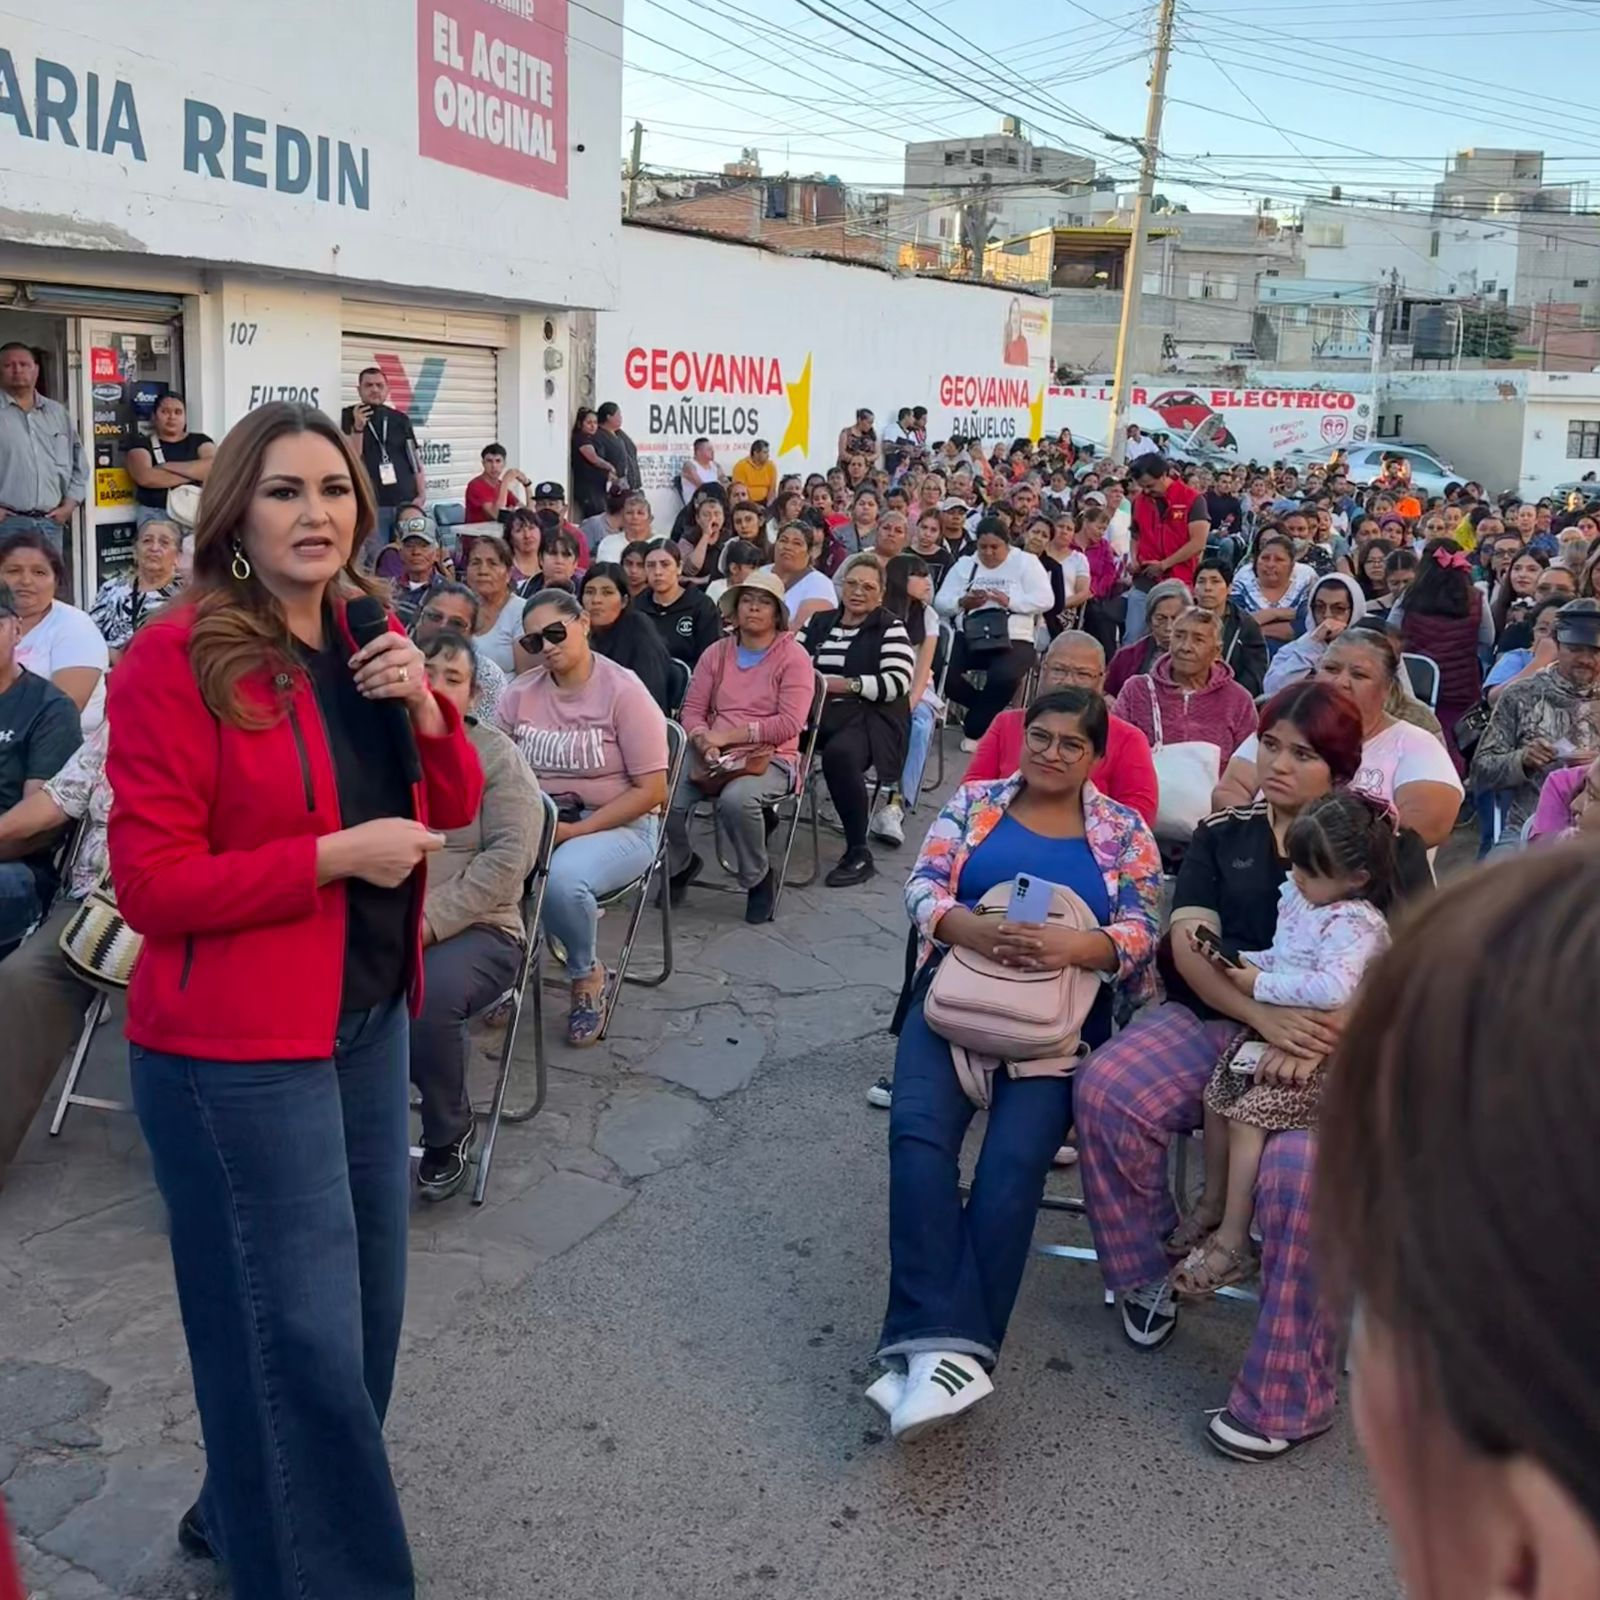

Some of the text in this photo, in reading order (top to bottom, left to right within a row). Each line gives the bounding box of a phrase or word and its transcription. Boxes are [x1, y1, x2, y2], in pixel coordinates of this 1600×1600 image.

[433, 11, 553, 109] EL ACEITE
[434, 75, 557, 164] ORIGINAL
[183, 98, 370, 210] REDIN
[230, 322, 257, 345] 107
[625, 347, 783, 396] GEOVANNA
[940, 374, 1029, 409] GEOVANNA
[1210, 390, 1356, 409] ELECTRICO
[650, 396, 759, 435] BAÑUELOS
[952, 410, 1016, 438] BAÑUELOS
